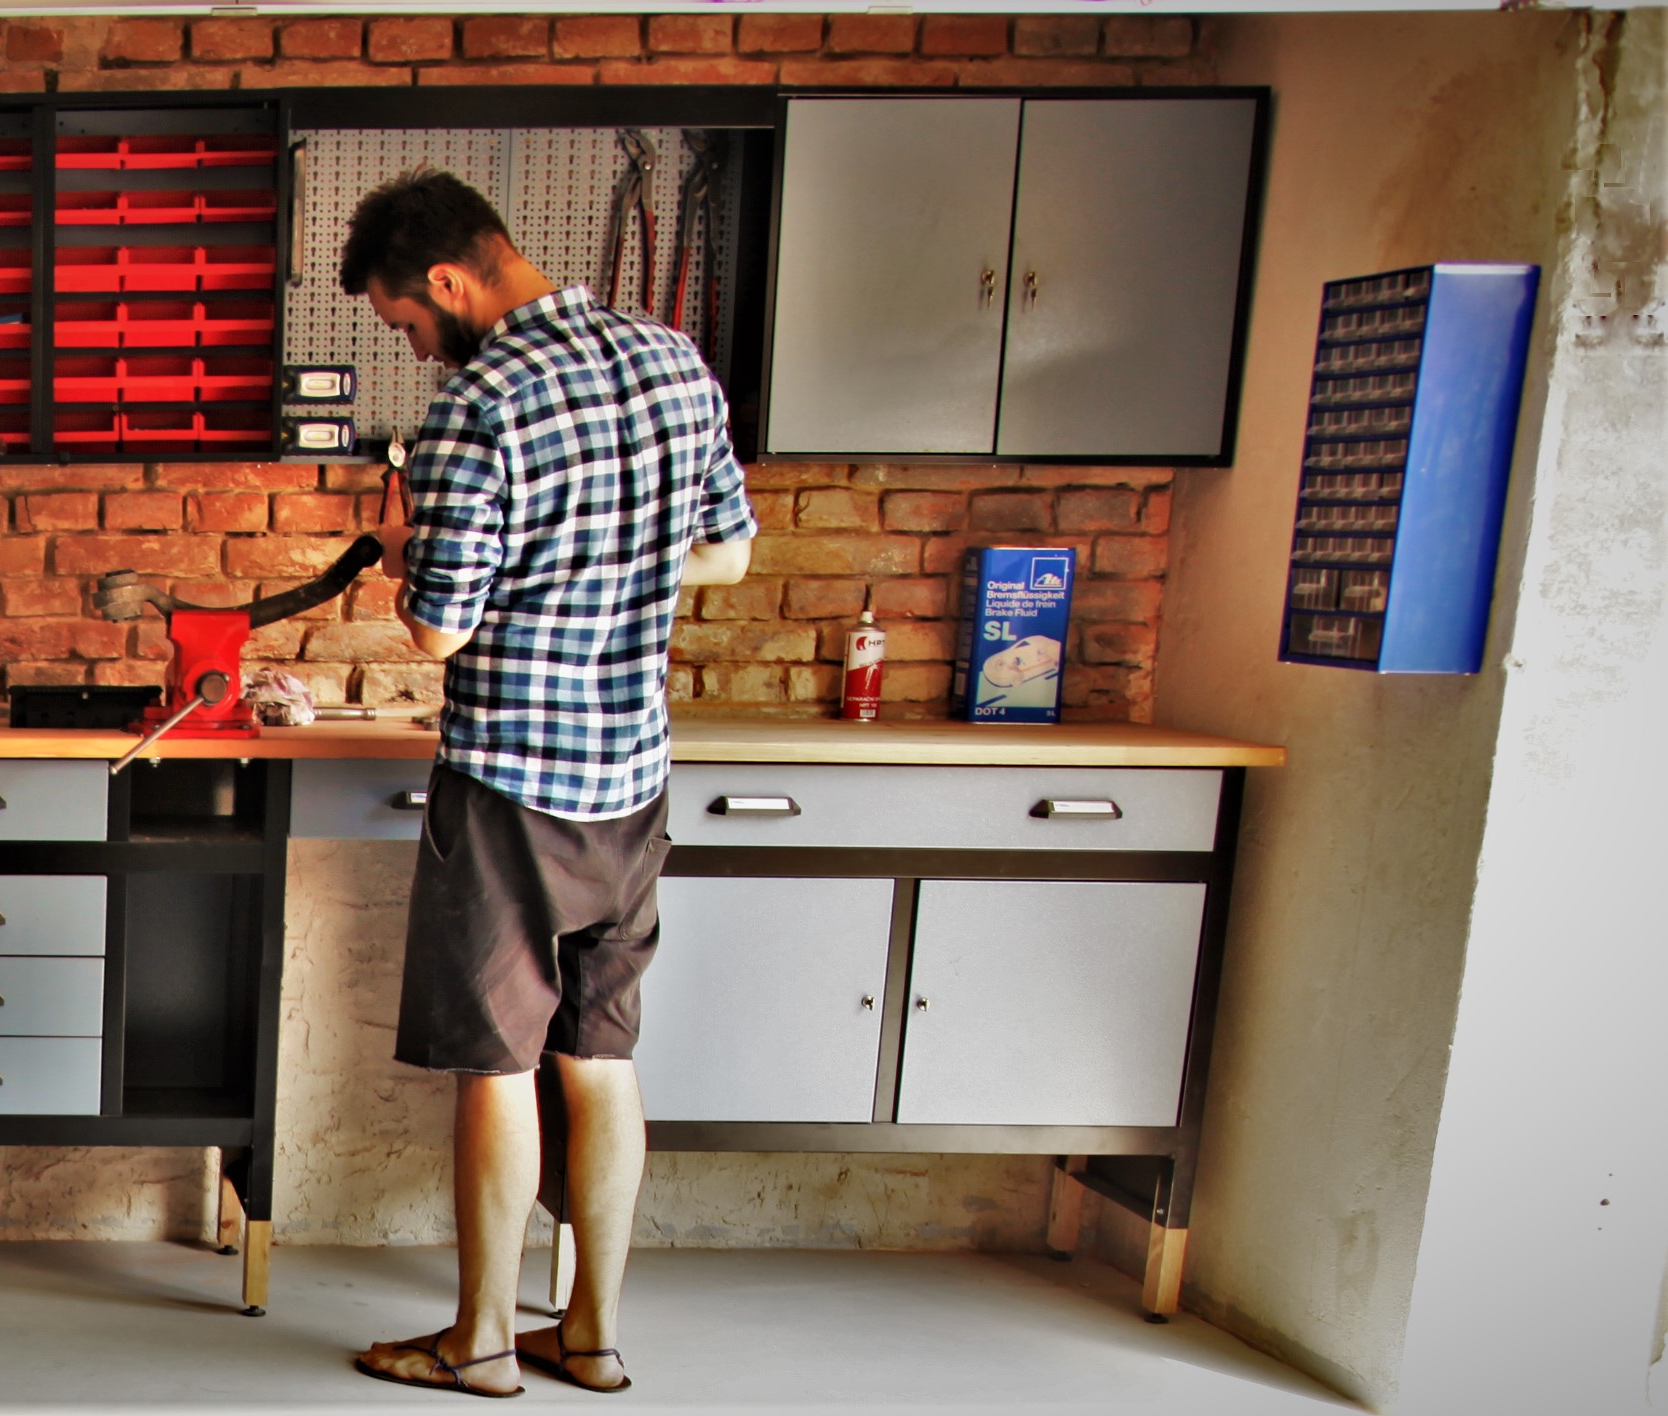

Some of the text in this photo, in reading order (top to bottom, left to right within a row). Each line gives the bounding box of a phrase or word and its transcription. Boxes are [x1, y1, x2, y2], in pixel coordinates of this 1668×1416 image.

[987, 580, 1025, 592] Original
[986, 590, 1065, 601] Bremsflüssigkeit
[985, 599, 1057, 609] Liquide de frein
[984, 608, 1038, 617] Brake Fluid
[983, 620, 1017, 641] SL
[975, 707, 1006, 716] DOT 4
